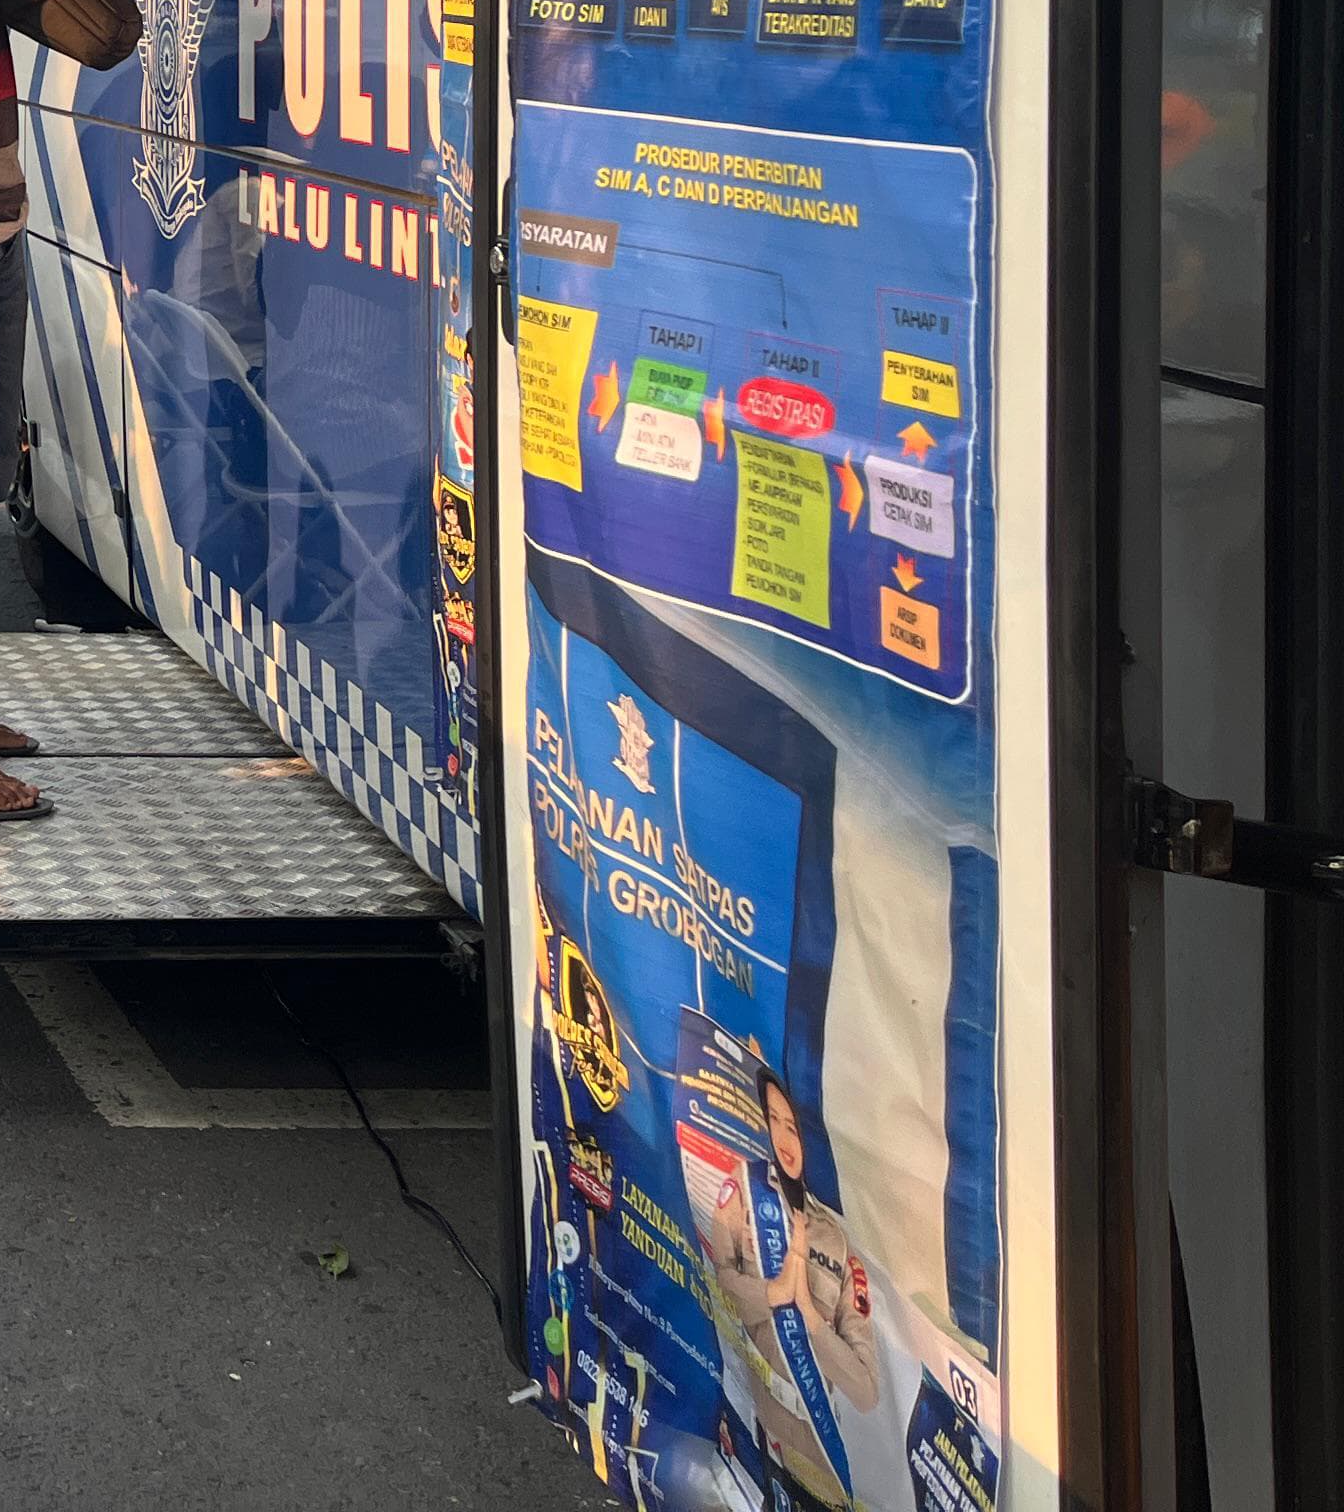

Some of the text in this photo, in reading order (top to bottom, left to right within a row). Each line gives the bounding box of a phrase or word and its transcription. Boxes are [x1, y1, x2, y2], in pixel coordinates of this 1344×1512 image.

[529, 0, 604, 24] FOTO SIM
[764, 12, 855, 37] TERAKREDITASI
[635, 143, 823, 190] PROSEDUR PENERBITAN
[238, 168, 330, 251] LALU
[595, 167, 859, 228] SIM A, C DAN D PERPANJANGAN
[649, 325, 695, 353] TAHAP
[891, 306, 933, 334] TAHAP
[762, 348, 809, 374] TAHAP
[886, 357, 955, 390] PENYERAHAN
[747, 388, 826, 432] REGISTRASI
[910, 385, 932, 404] SIM
[880, 477, 933, 509] PRODUKSI
[883, 501, 933, 534] CETAK SIM
[674, 841, 756, 938] SATPAS
[608, 869, 754, 999] GROBOGAN
[621, 1210, 686, 1288] YANDUAN
[781, 1308, 818, 1402] PELAYANAN
[953, 1370, 977, 1417] 03
